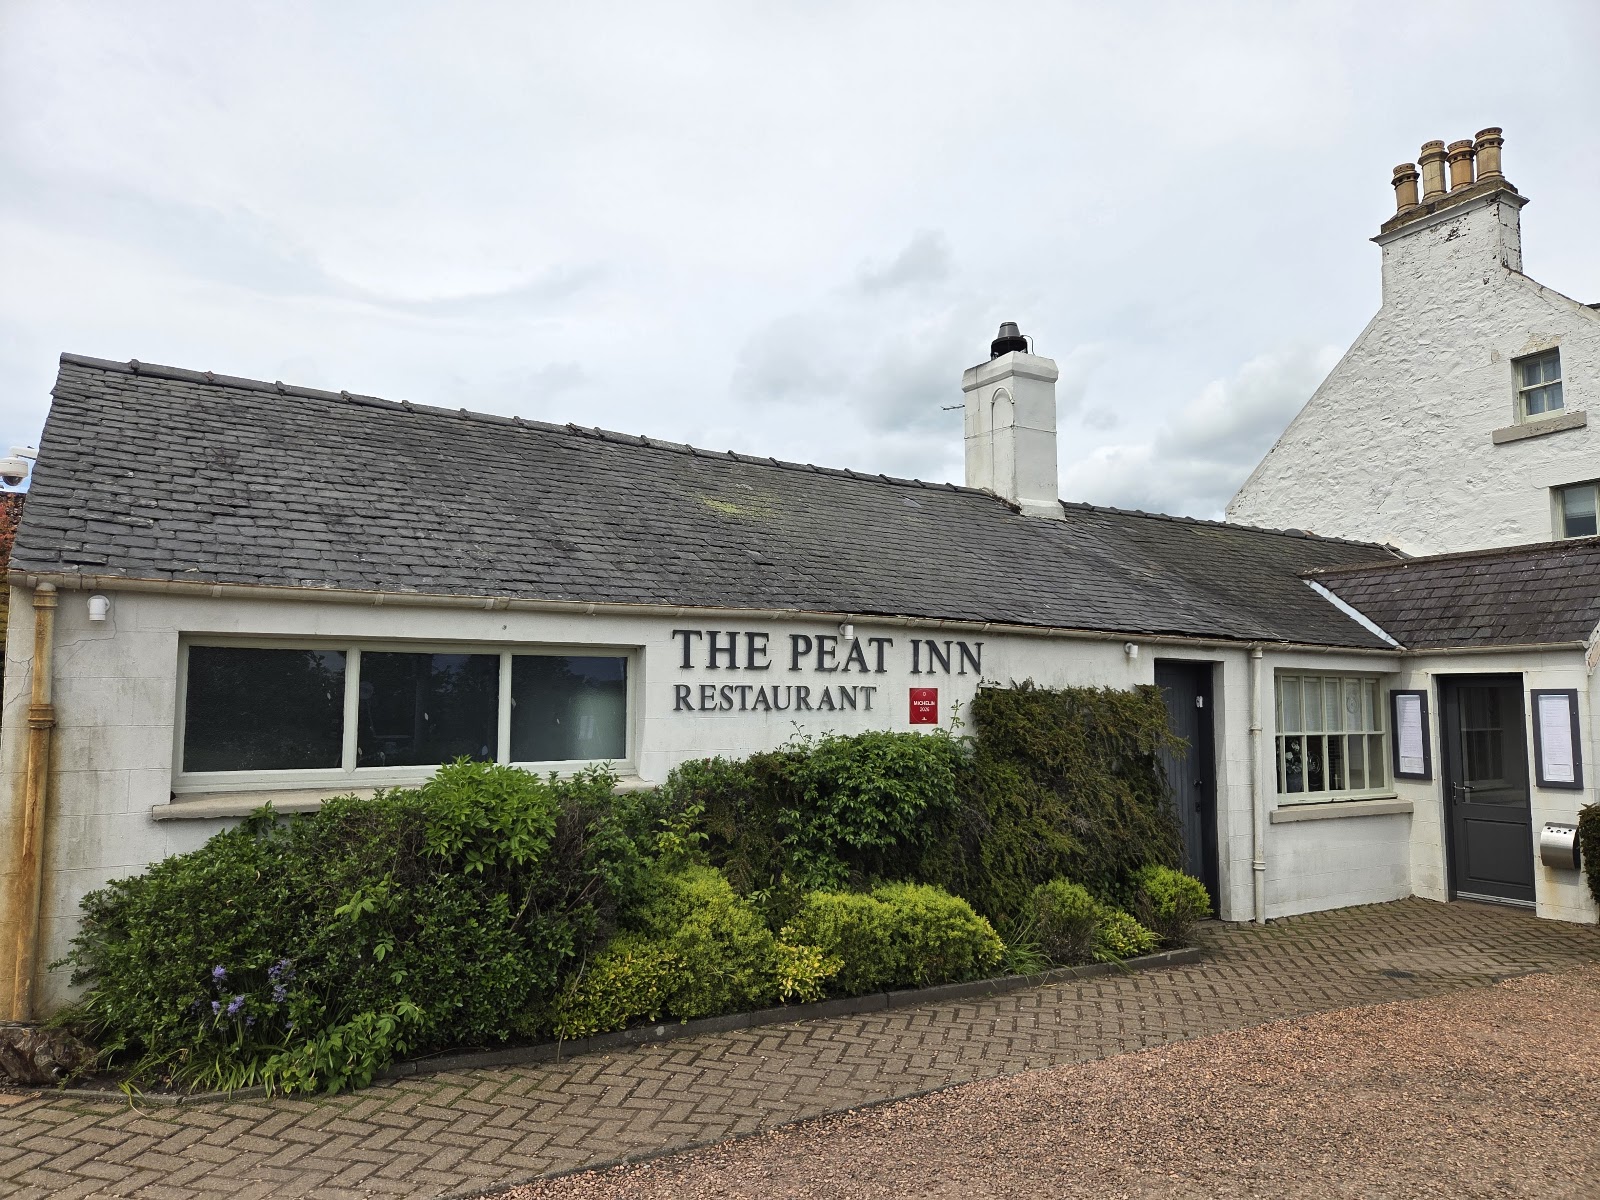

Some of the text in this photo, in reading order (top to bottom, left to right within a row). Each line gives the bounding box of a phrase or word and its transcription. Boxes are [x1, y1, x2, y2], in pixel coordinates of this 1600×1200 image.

[672, 629, 985, 676] THE PEAT INN
[672, 684, 878, 711] RESTAURANT
